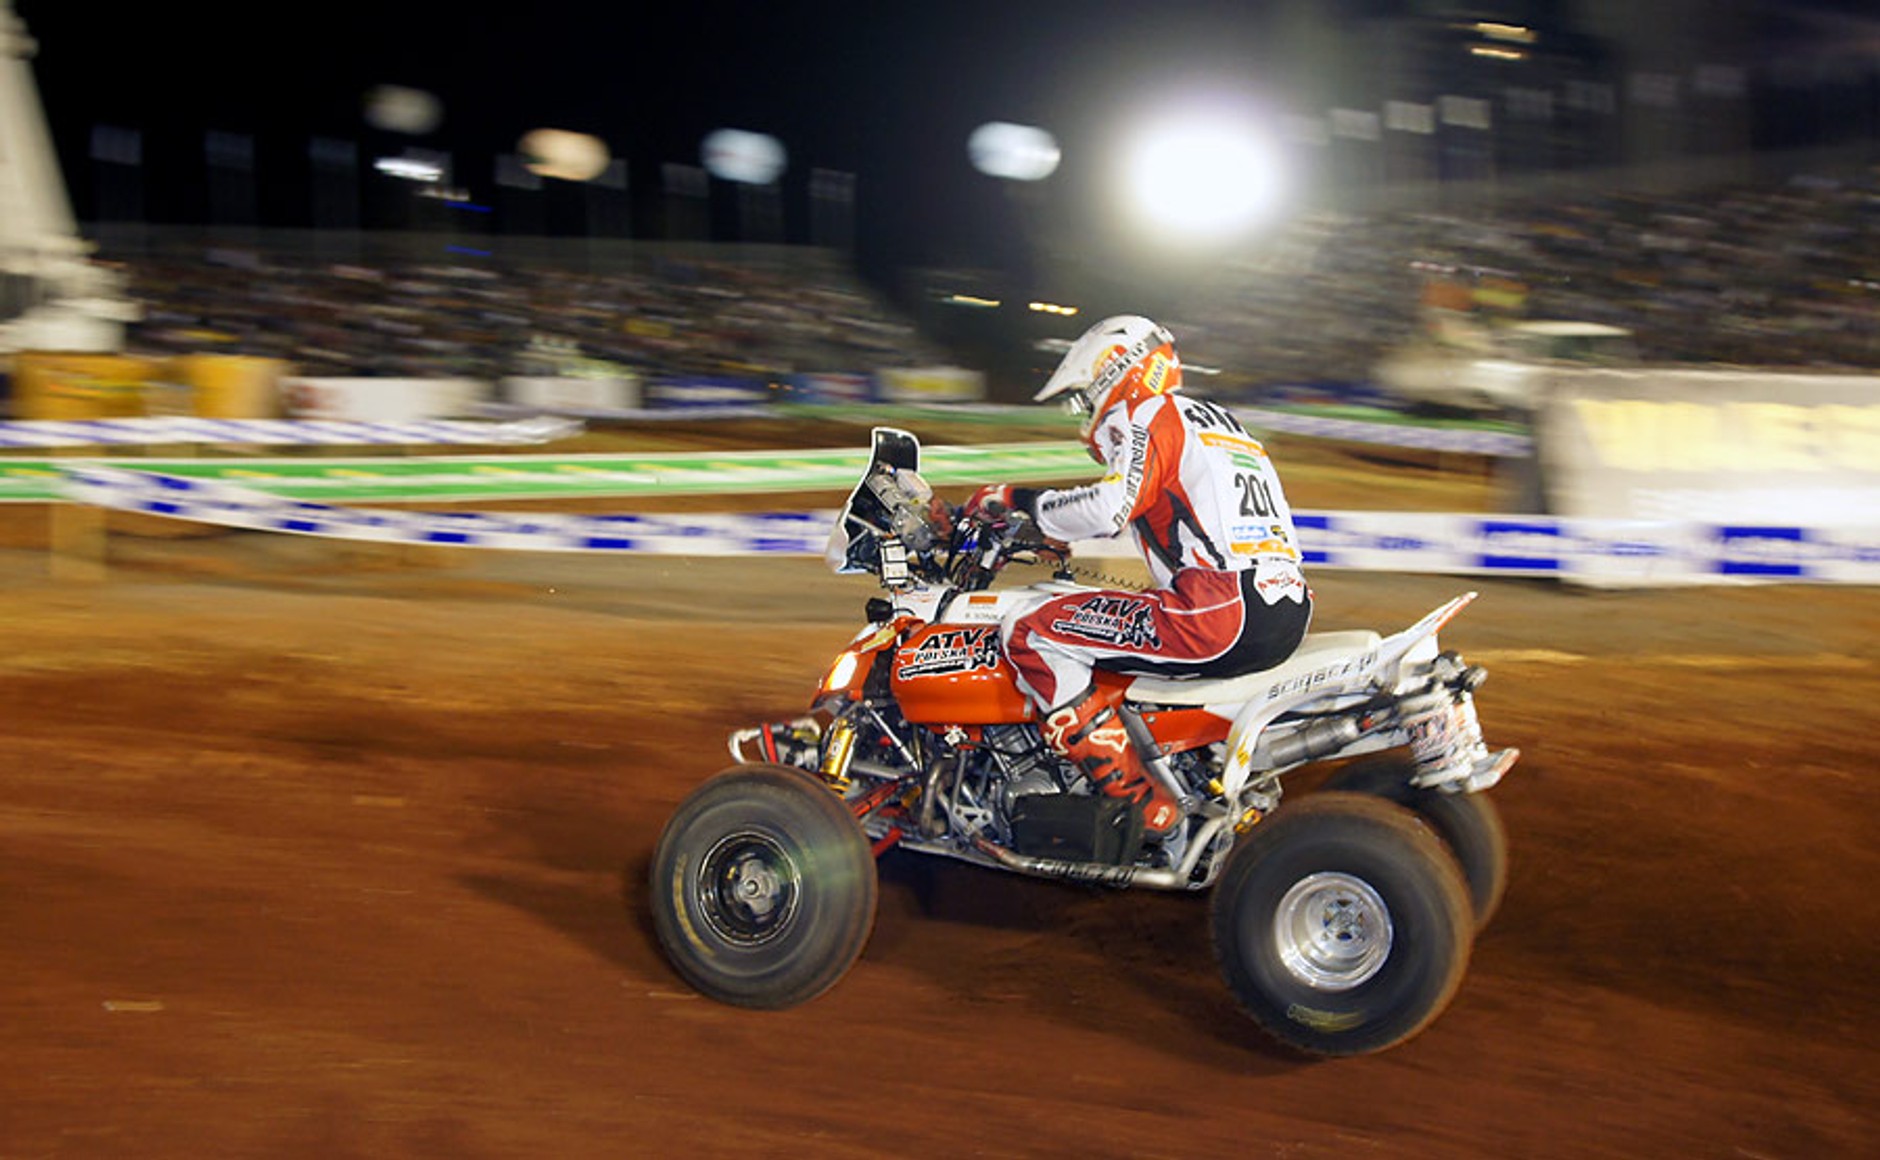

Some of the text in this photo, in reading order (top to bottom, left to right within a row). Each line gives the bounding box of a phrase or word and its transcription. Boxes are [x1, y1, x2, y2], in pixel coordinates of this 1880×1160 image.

[1233, 472, 1280, 518] 201
[1080, 597, 1143, 617] ATV
[919, 628, 983, 651] ATV
[915, 647, 967, 662] POLSKA
